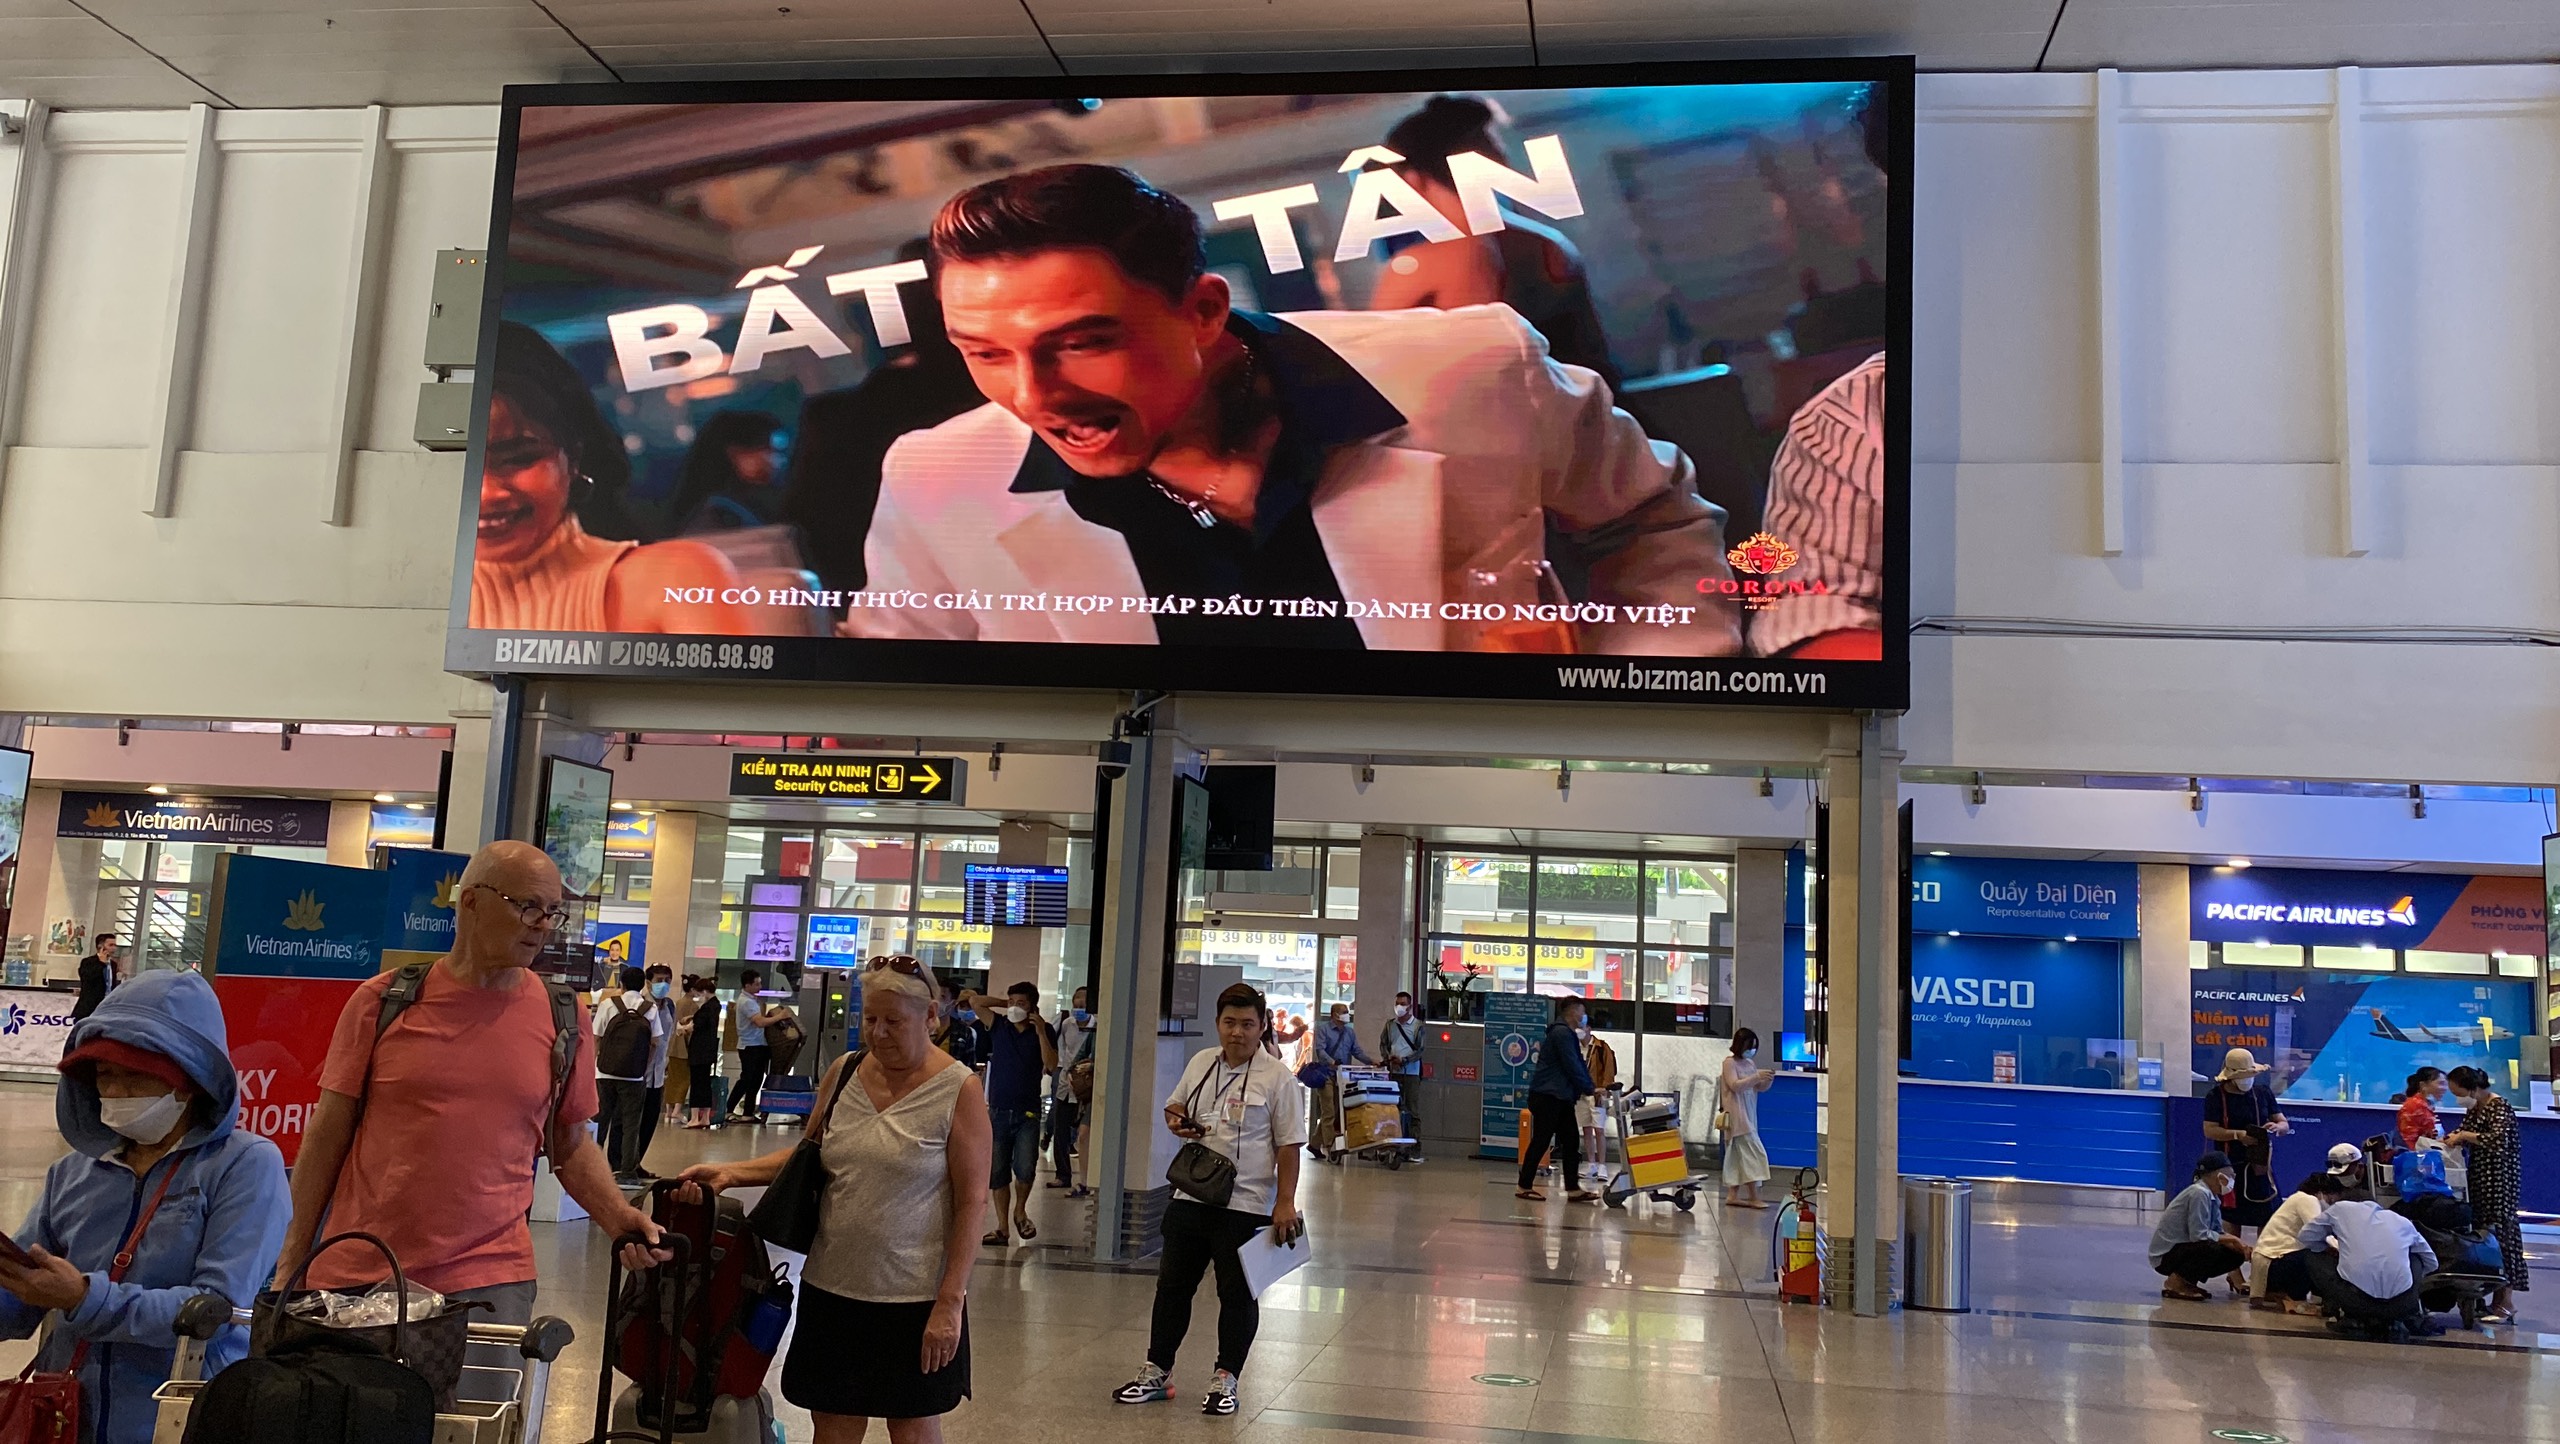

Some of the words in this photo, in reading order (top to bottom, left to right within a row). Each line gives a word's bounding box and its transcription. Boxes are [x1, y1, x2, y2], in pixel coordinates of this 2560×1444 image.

[607, 244, 928, 393] BẤT
[1696, 577, 1828, 595] CORONA
[663, 586, 714, 604] NƠI
[721, 585, 761, 606] CÓ
[768, 585, 842, 608] HÌNH
[847, 589, 927, 609] THỨC
[933, 588, 993, 610] GIẢI
[1000, 592, 1046, 611] TRÍ
[1053, 594, 1114, 616] HỢP
[1121, 594, 1197, 614] PHÁP
[1202, 593, 1264, 616] ĐẦU
[1269, 597, 1338, 618] TIÊN
[1344, 598, 1433, 620] DÀNH
[1439, 602, 1507, 621] CHO
[1512, 600, 1617, 623] NGƯỜI
[1626, 602, 1696, 627] VIỆT
[495, 637, 602, 665] BIZMAN
[633, 641, 774, 670] 094.986.98.98
[1557, 662, 1826, 694] www.bizman.com.vn
[741, 757, 777, 776] KIỂM
[780, 763, 809, 776] TRA
[812, 764, 832, 777] AN
[836, 765, 871, 778] NINH
[774, 779, 826, 794] Security
[829, 781, 869, 793] Check
[124, 809, 200, 831] Vietnam
[201, 812, 273, 833] Airlines
[1980, 880, 2028, 906] Quầy
[2036, 882, 2067, 906] Đại
[2073, 884, 2117, 907] Diện
[403, 911, 448, 932] Vietnam
[1986, 906, 2066, 919] Representative
[2069, 910, 2111, 920] Counter
[2207, 903, 2285, 921] PACIFIC
[2287, 905, 2386, 927] AIRLINES
[2471, 904, 2527, 919] PHÒNG
[2531, 909, 2545, 919] V
[2471, 921, 2504, 931] TICKET
[2507, 923, 2546, 932] COUNTE
[246, 933, 303, 957] Vietnam
[305, 937, 352, 959] Airlines
[1473, 943, 1585, 960] 0969.3.89.89
[1912, 976, 2035, 1009] VASCO
[2194, 990, 2237, 1001] PACIFIC
[2238, 992, 2290, 1002] AIRLINES
[30, 1014, 77, 1027] SASC
[2194, 1009, 2239, 1026] Niềm
[2243, 1013, 2270, 1027] vui
[1456, 1067, 1475, 1075] PCCC
